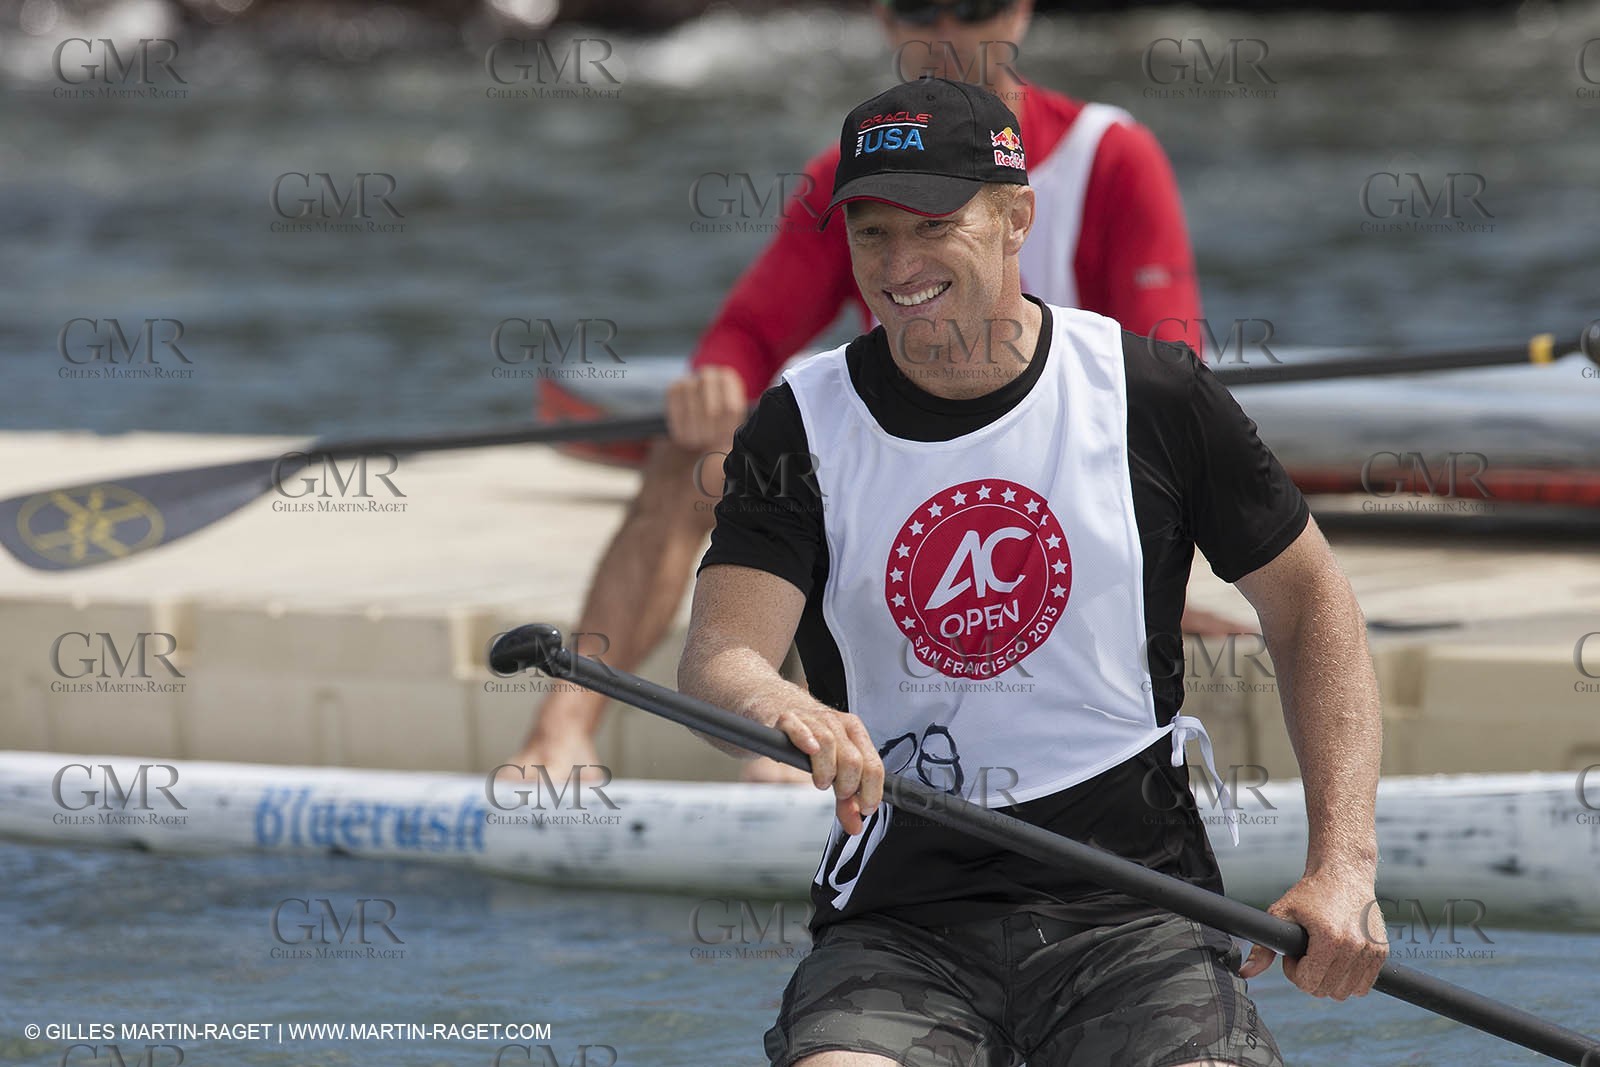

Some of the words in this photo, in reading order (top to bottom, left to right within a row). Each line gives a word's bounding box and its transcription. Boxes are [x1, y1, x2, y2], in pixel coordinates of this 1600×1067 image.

[860, 111, 929, 129] ORACLE
[864, 128, 925, 153] USA
[924, 526, 1032, 610] AC
[915, 635, 942, 664] SAN
[1029, 605, 1058, 643] 2013
[939, 599, 1020, 639] OPEN
